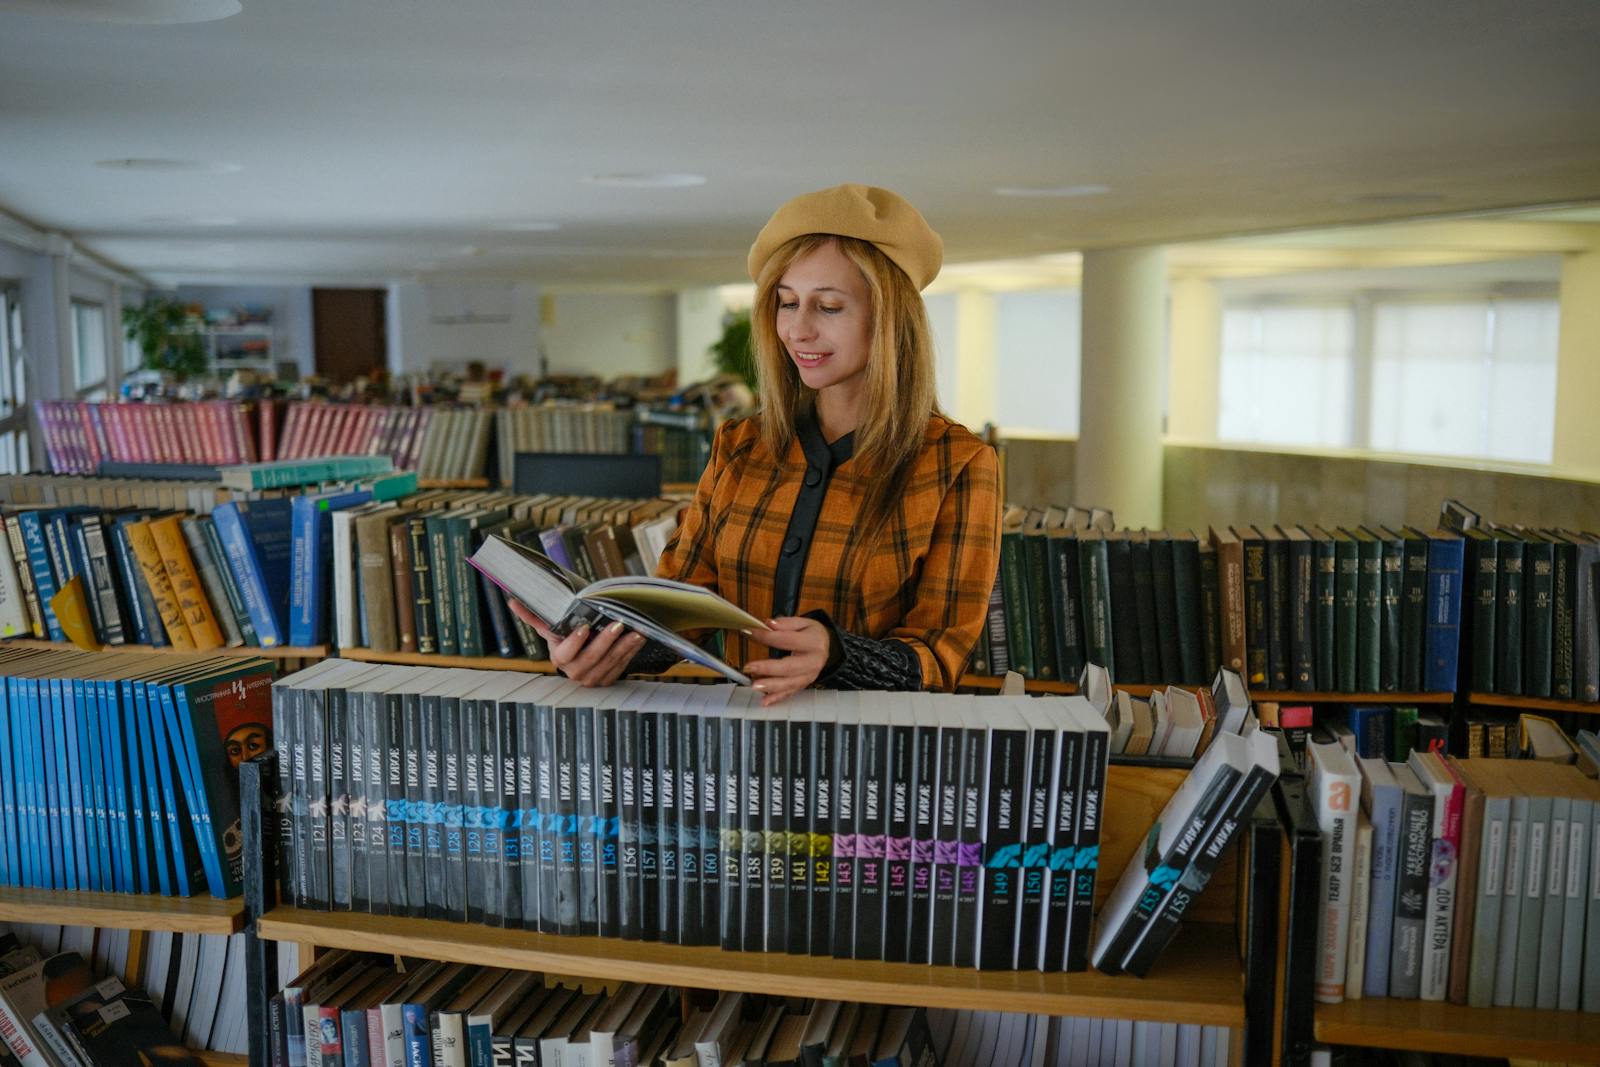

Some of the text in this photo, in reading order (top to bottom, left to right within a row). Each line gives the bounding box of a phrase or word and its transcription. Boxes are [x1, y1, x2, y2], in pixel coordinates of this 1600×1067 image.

[278, 741, 289, 778] НОВОЕ
[294, 743, 305, 781] НОВОЕ
[312, 744, 323, 782] НОВОЕ
[332, 743, 343, 780] НОВОЕ
[352, 744, 363, 782] НОВОЕ
[370, 748, 382, 785] НОВОЕ
[389, 748, 401, 785] НОВОЕ
[407, 749, 418, 787] НОВОЕ
[427, 750, 438, 788] НОВОЕ
[446, 753, 457, 791] НОВОЕ
[466, 754, 478, 792] НОВОЕ
[483, 754, 495, 792] НОВОЕ
[504, 757, 515, 796] НОВОЕ
[520, 756, 532, 795] НОВОЕ
[539, 760, 551, 799] НОВОЕ
[560, 761, 571, 801] НОВОЕ
[580, 762, 591, 801] НОВОЕ
[602, 765, 613, 803] НОВОЕ
[623, 767, 634, 806] НОВОЕ
[642, 768, 654, 808] НОВОЕ
[662, 769, 673, 808] НОВОЕ
[683, 771, 695, 811] НОВОЕ
[704, 772, 715, 812] НОВОЕ
[725, 774, 737, 814] НОВОЕ
[748, 776, 760, 816] НОВОЕ
[771, 777, 782, 816] НОВОЕ
[794, 777, 805, 817] НОВОЕ
[817, 779, 830, 819] НОВОЕ
[840, 779, 852, 819] НОВОЕ
[866, 780, 879, 820] НОВОЕ
[893, 782, 906, 822] НОВОЕ
[917, 784, 930, 824] НОВОЕ
[942, 785, 956, 826] НОВОЕ
[965, 787, 979, 828] НОВОЕ
[998, 789, 1013, 829] НОВОЕ
[1032, 788, 1046, 829] НОВОЕ
[1059, 791, 1074, 832] НОВОЕ
[1083, 790, 1099, 830] НОВОЕ
[279, 818, 293, 837] 119
[312, 824, 325, 843] 121
[332, 821, 345, 841] 122
[352, 822, 365, 842] 123
[371, 826, 385, 846] 124
[390, 826, 403, 846] 125
[408, 828, 422, 848] 126
[427, 829, 440, 849] 127
[448, 832, 461, 853] 128
[468, 832, 481, 853] 129
[484, 832, 498, 854] 130
[521, 835, 534, 857] 132
[1177, 817, 1206, 856] НОВОЕ
[1206, 818, 1237, 858] НОВОЕ
[504, 837, 518, 857] 131
[541, 840, 553, 862] 133
[560, 841, 574, 863] 134
[581, 842, 594, 864] 135
[603, 843, 616, 865] 136
[623, 847, 637, 868] 156
[643, 850, 656, 871] 157
[662, 850, 675, 871] 158
[683, 852, 697, 874] 159
[704, 853, 718, 874] 160
[1328, 818, 1344, 902] ТЕАТР БЕЗ ВРАНЬЯ
[725, 856, 739, 878] 137
[747, 857, 761, 880] 138
[770, 858, 784, 880] 139
[792, 860, 806, 881] 141
[816, 861, 830, 883] 142
[838, 862, 852, 884] 143
[864, 862, 878, 885] 144
[891, 865, 906, 887] 145
[915, 867, 929, 889] 146
[940, 869, 954, 890] 147
[963, 871, 977, 893] 148
[994, 872, 1009, 895] 149
[1027, 871, 1042, 894] 150
[1078, 875, 1093, 896] 152
[1054, 876, 1069, 897] 151
[1143, 889, 1161, 914] 153
[1170, 891, 1191, 914] 155
[1435, 888, 1450, 911] ДОМ
